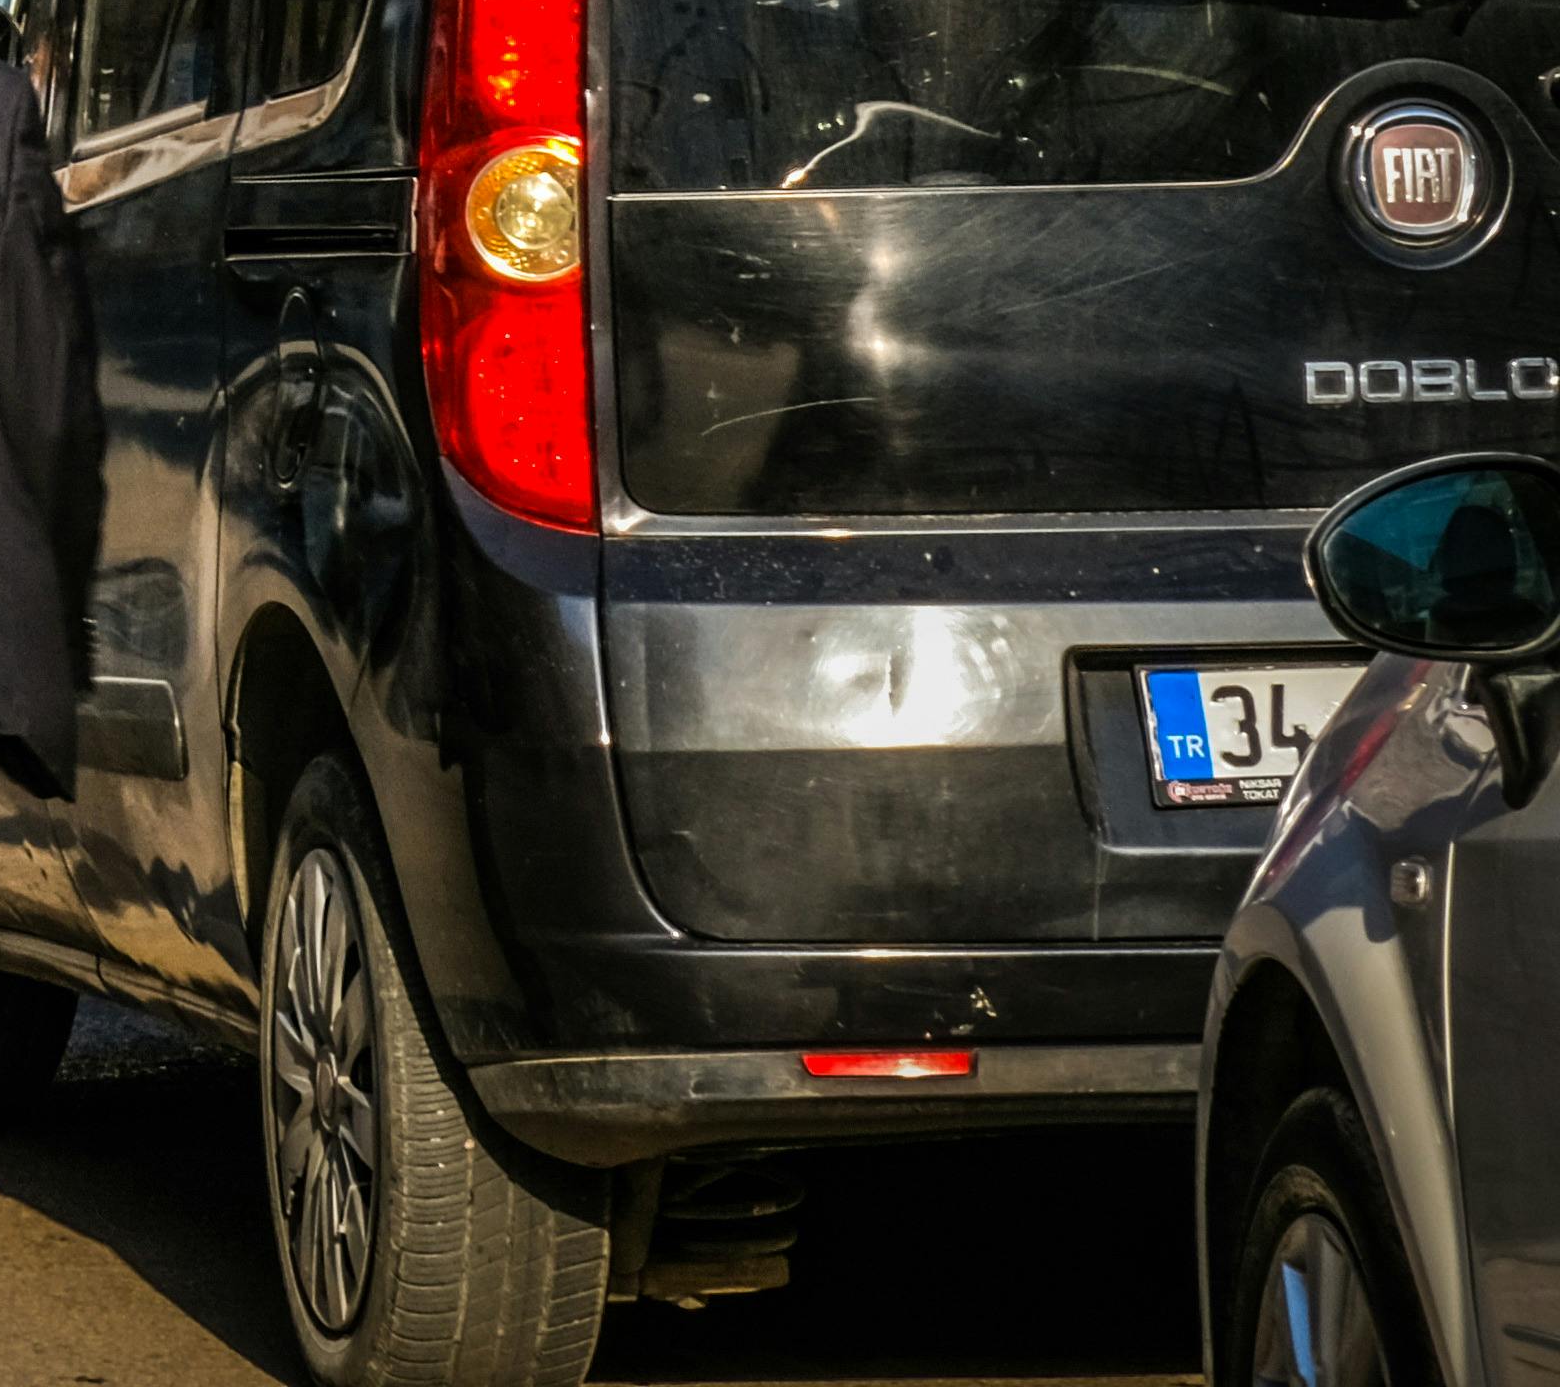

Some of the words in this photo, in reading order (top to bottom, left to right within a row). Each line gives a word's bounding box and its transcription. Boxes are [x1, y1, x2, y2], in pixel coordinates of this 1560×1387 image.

[1382, 146, 1456, 205] FIAT
[1303, 355, 1560, 406] DOBLO
[1166, 735, 1206, 759] TR
[1210, 683, 1314, 768] 34
[1242, 789, 1280, 801] TOKAT
